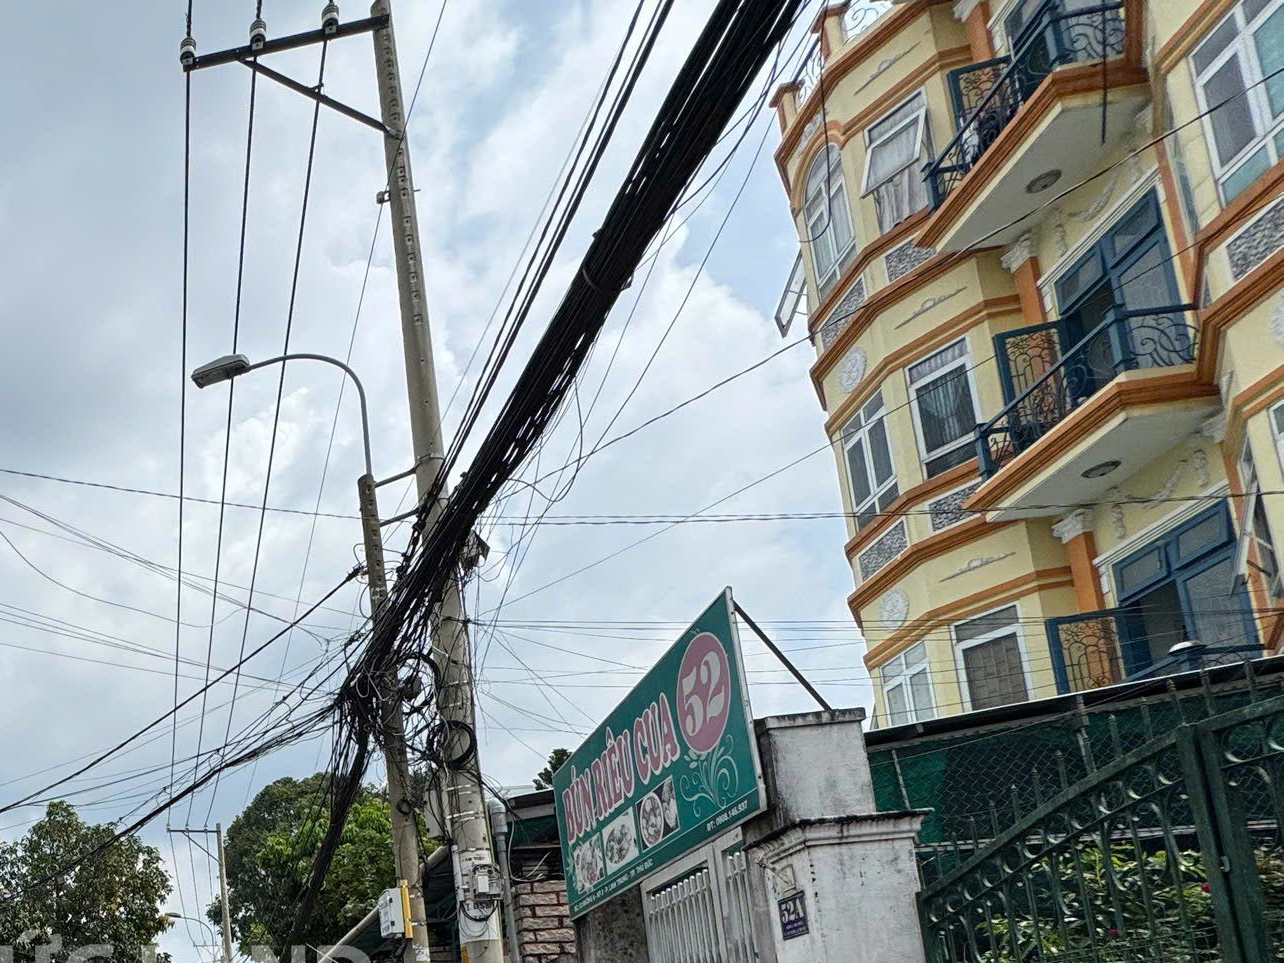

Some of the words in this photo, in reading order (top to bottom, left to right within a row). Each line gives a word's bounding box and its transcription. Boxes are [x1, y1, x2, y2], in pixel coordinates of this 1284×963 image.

[682, 651, 725, 738] 52
[562, 765, 596, 845] BÚN
[591, 725, 635, 822] RIÊU
[633, 692, 680, 785] CUA
